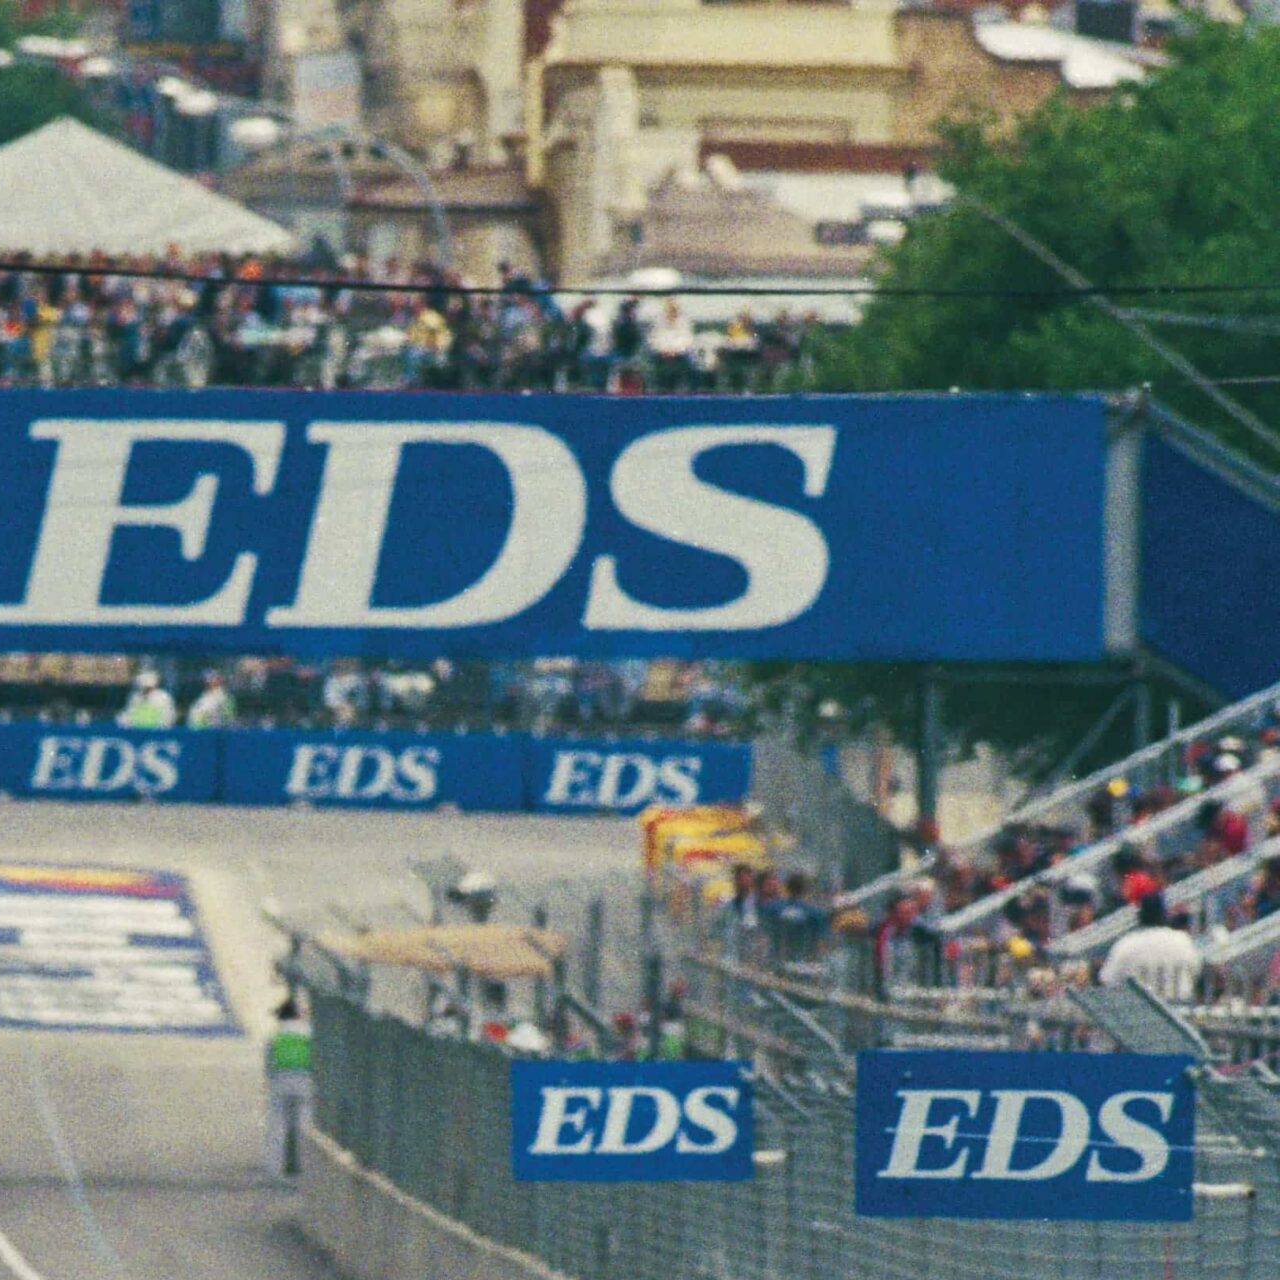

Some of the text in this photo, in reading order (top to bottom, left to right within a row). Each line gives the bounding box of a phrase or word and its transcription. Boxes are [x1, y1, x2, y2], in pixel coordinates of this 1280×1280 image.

[32, 735, 181, 794] EDS
[285, 743, 440, 800] EDS
[544, 750, 712, 806] EDS
[529, 1086, 1175, 1183] EDS EDS
